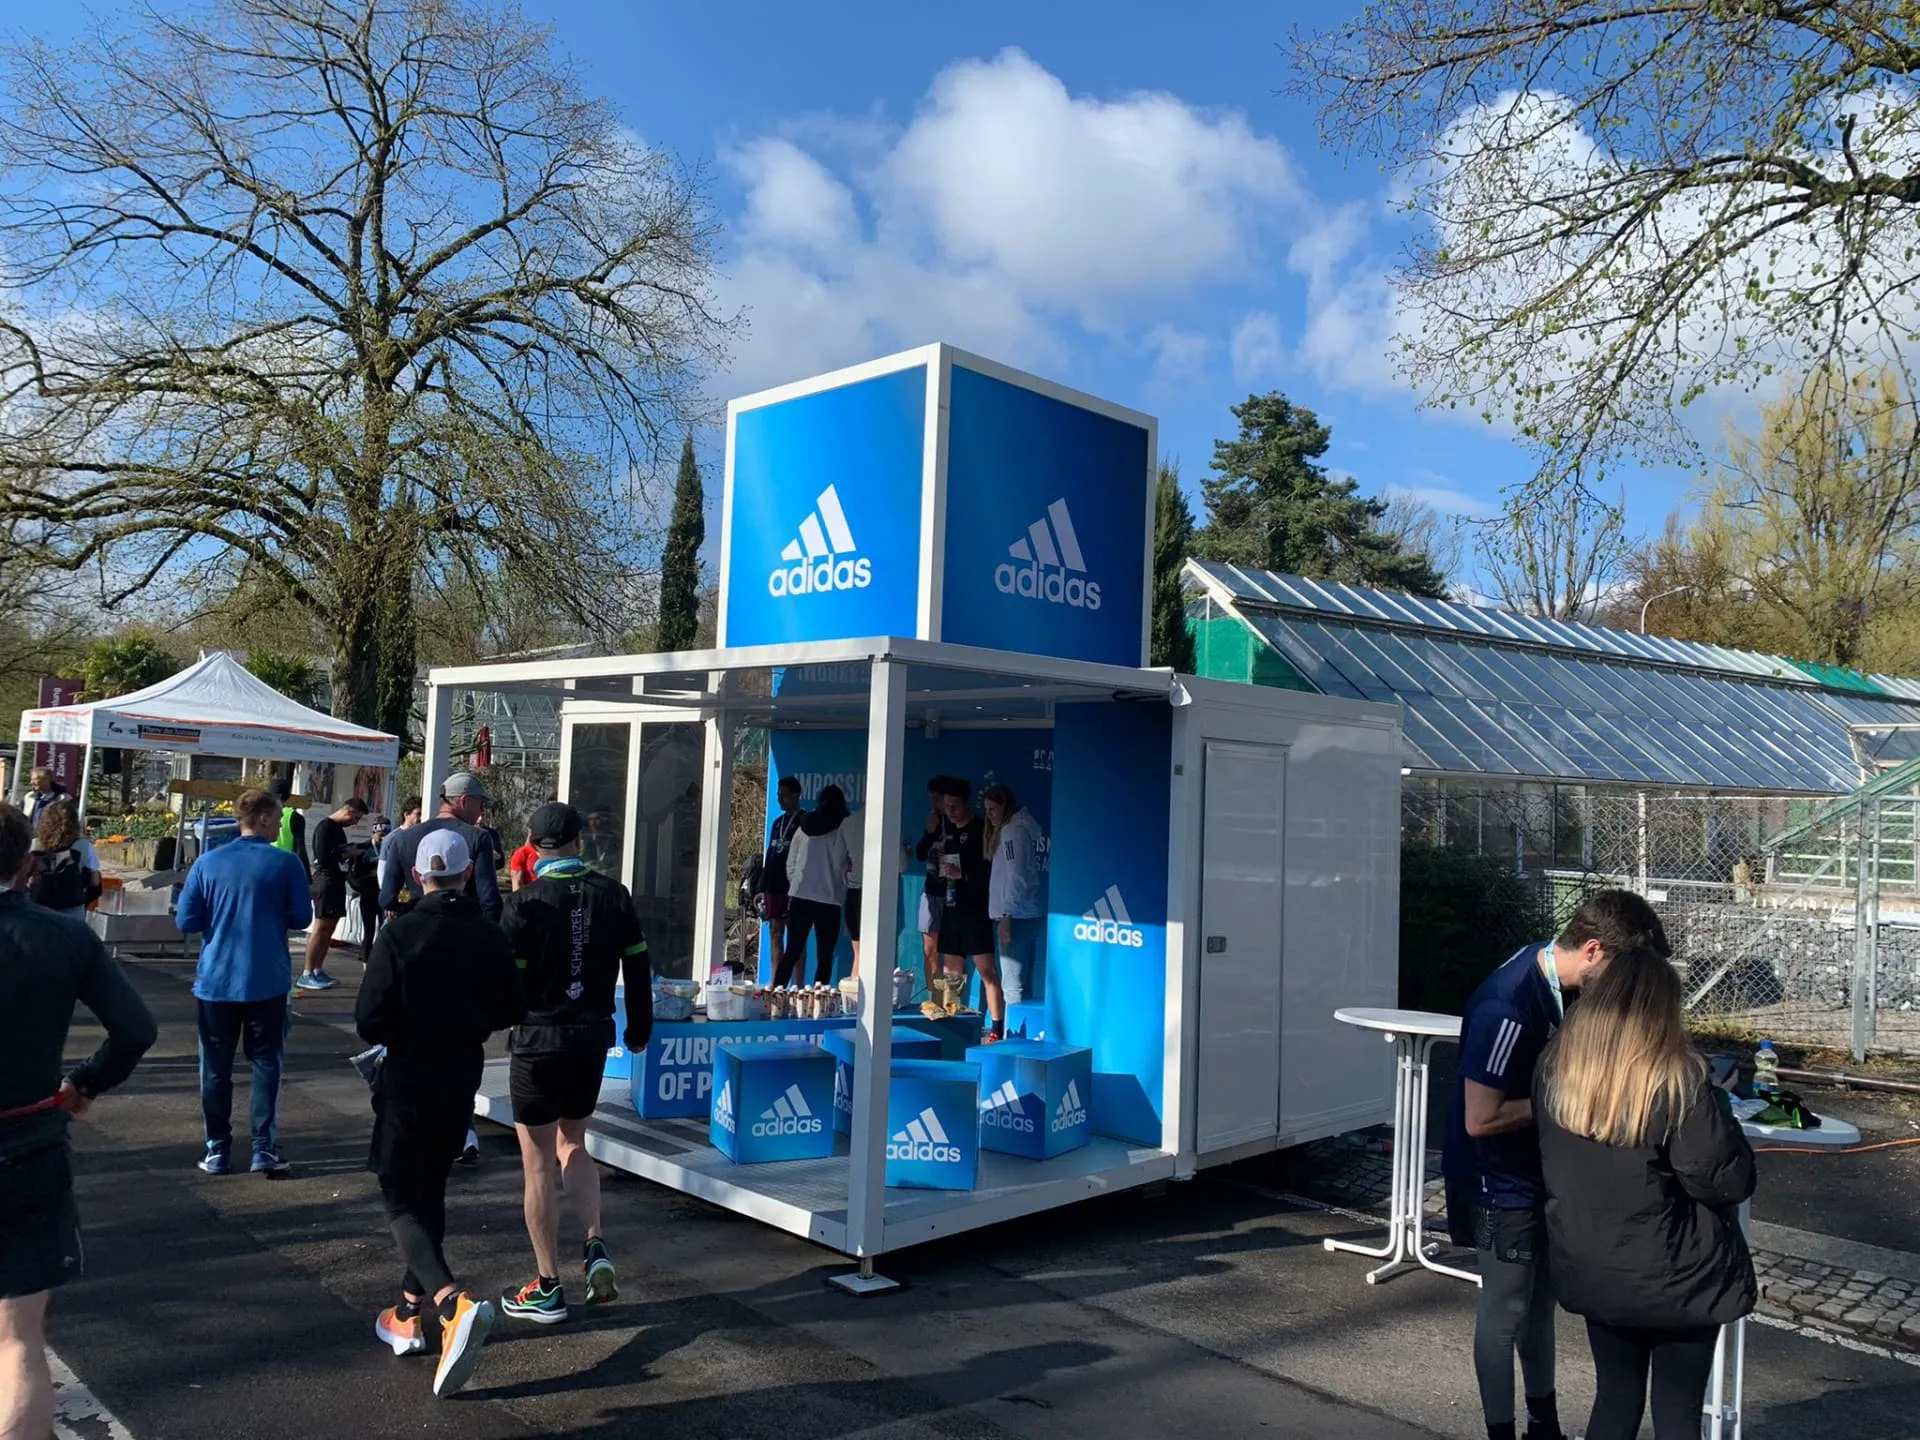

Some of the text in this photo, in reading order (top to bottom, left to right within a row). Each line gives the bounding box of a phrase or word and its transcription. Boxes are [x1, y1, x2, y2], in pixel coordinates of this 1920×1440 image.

[769, 554, 872, 597] adidas
[994, 560, 1101, 610] adidas
[570, 907, 582, 976] SCHWEIZER
[1074, 919, 1143, 948] adidas
[658, 1072, 693, 1101] OF
[752, 1115, 822, 1137] adidas
[1052, 1109, 1087, 1133] adidas
[886, 1141, 961, 1163] adidas
